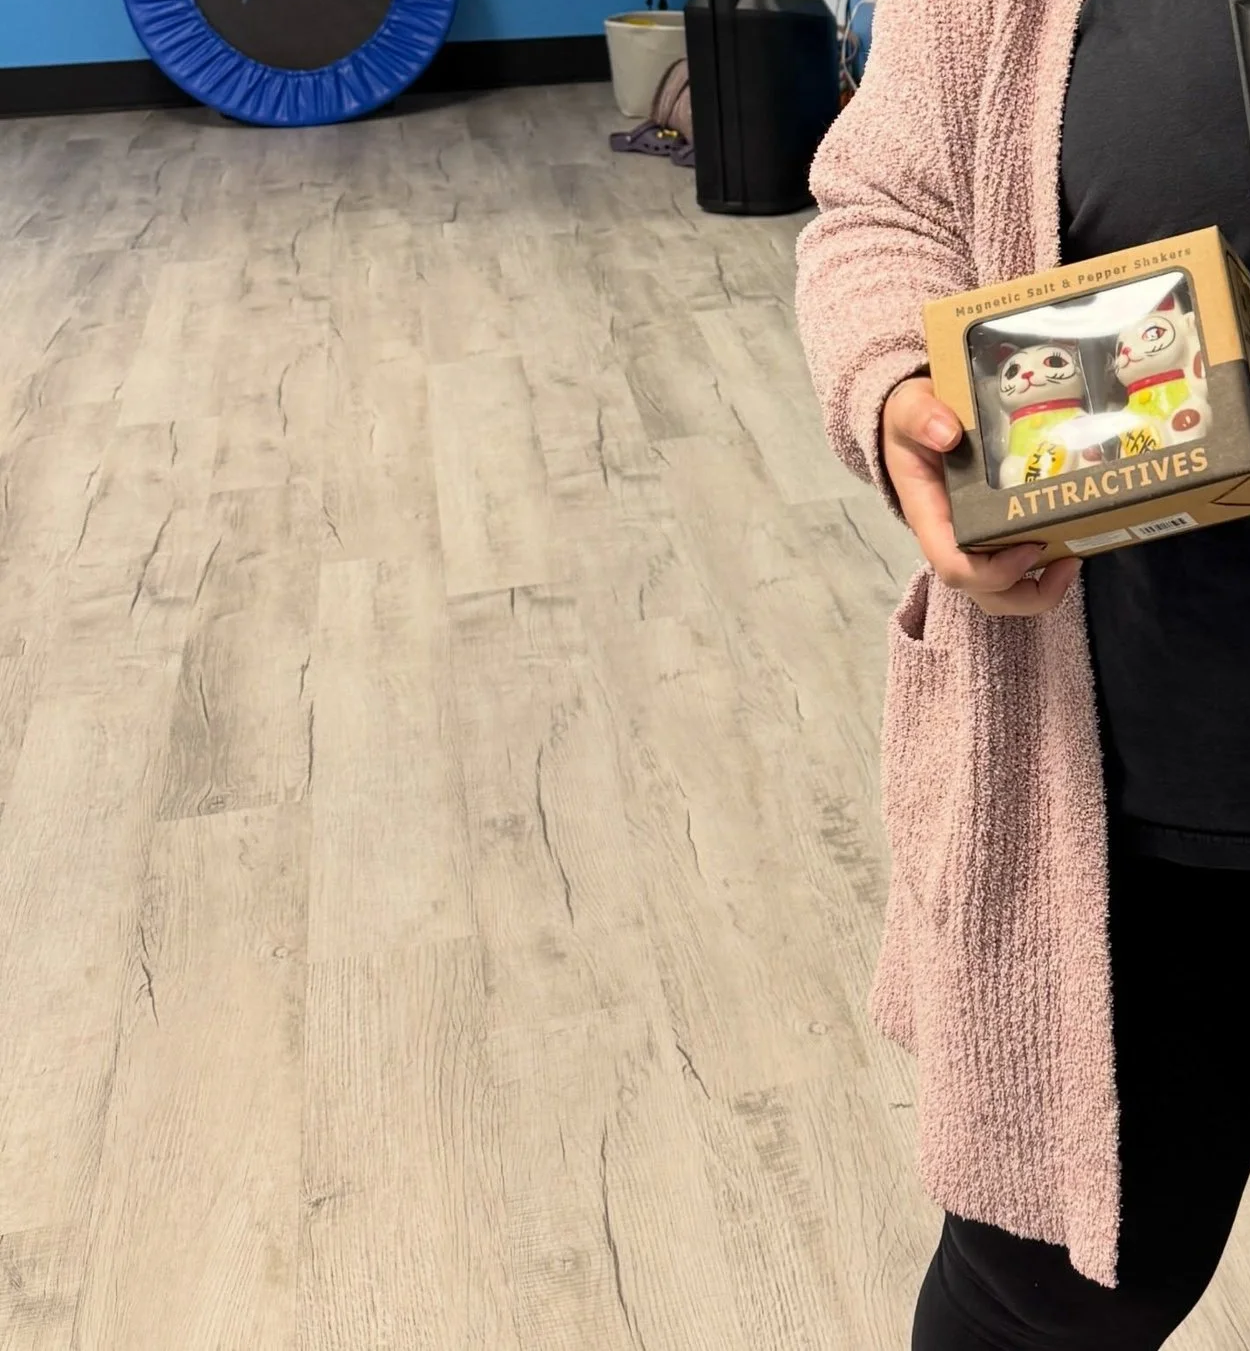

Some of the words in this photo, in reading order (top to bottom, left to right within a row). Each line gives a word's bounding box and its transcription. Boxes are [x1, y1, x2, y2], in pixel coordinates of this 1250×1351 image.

[955, 293, 1021, 317] Magnetic
[1027, 284, 1056, 299] Salt
[1062, 278, 1071, 289] &
[1078, 264, 1127, 285] Pepper
[1134, 248, 1192, 270] Shakers
[1006, 446, 1209, 521] ATTRACTIVES
